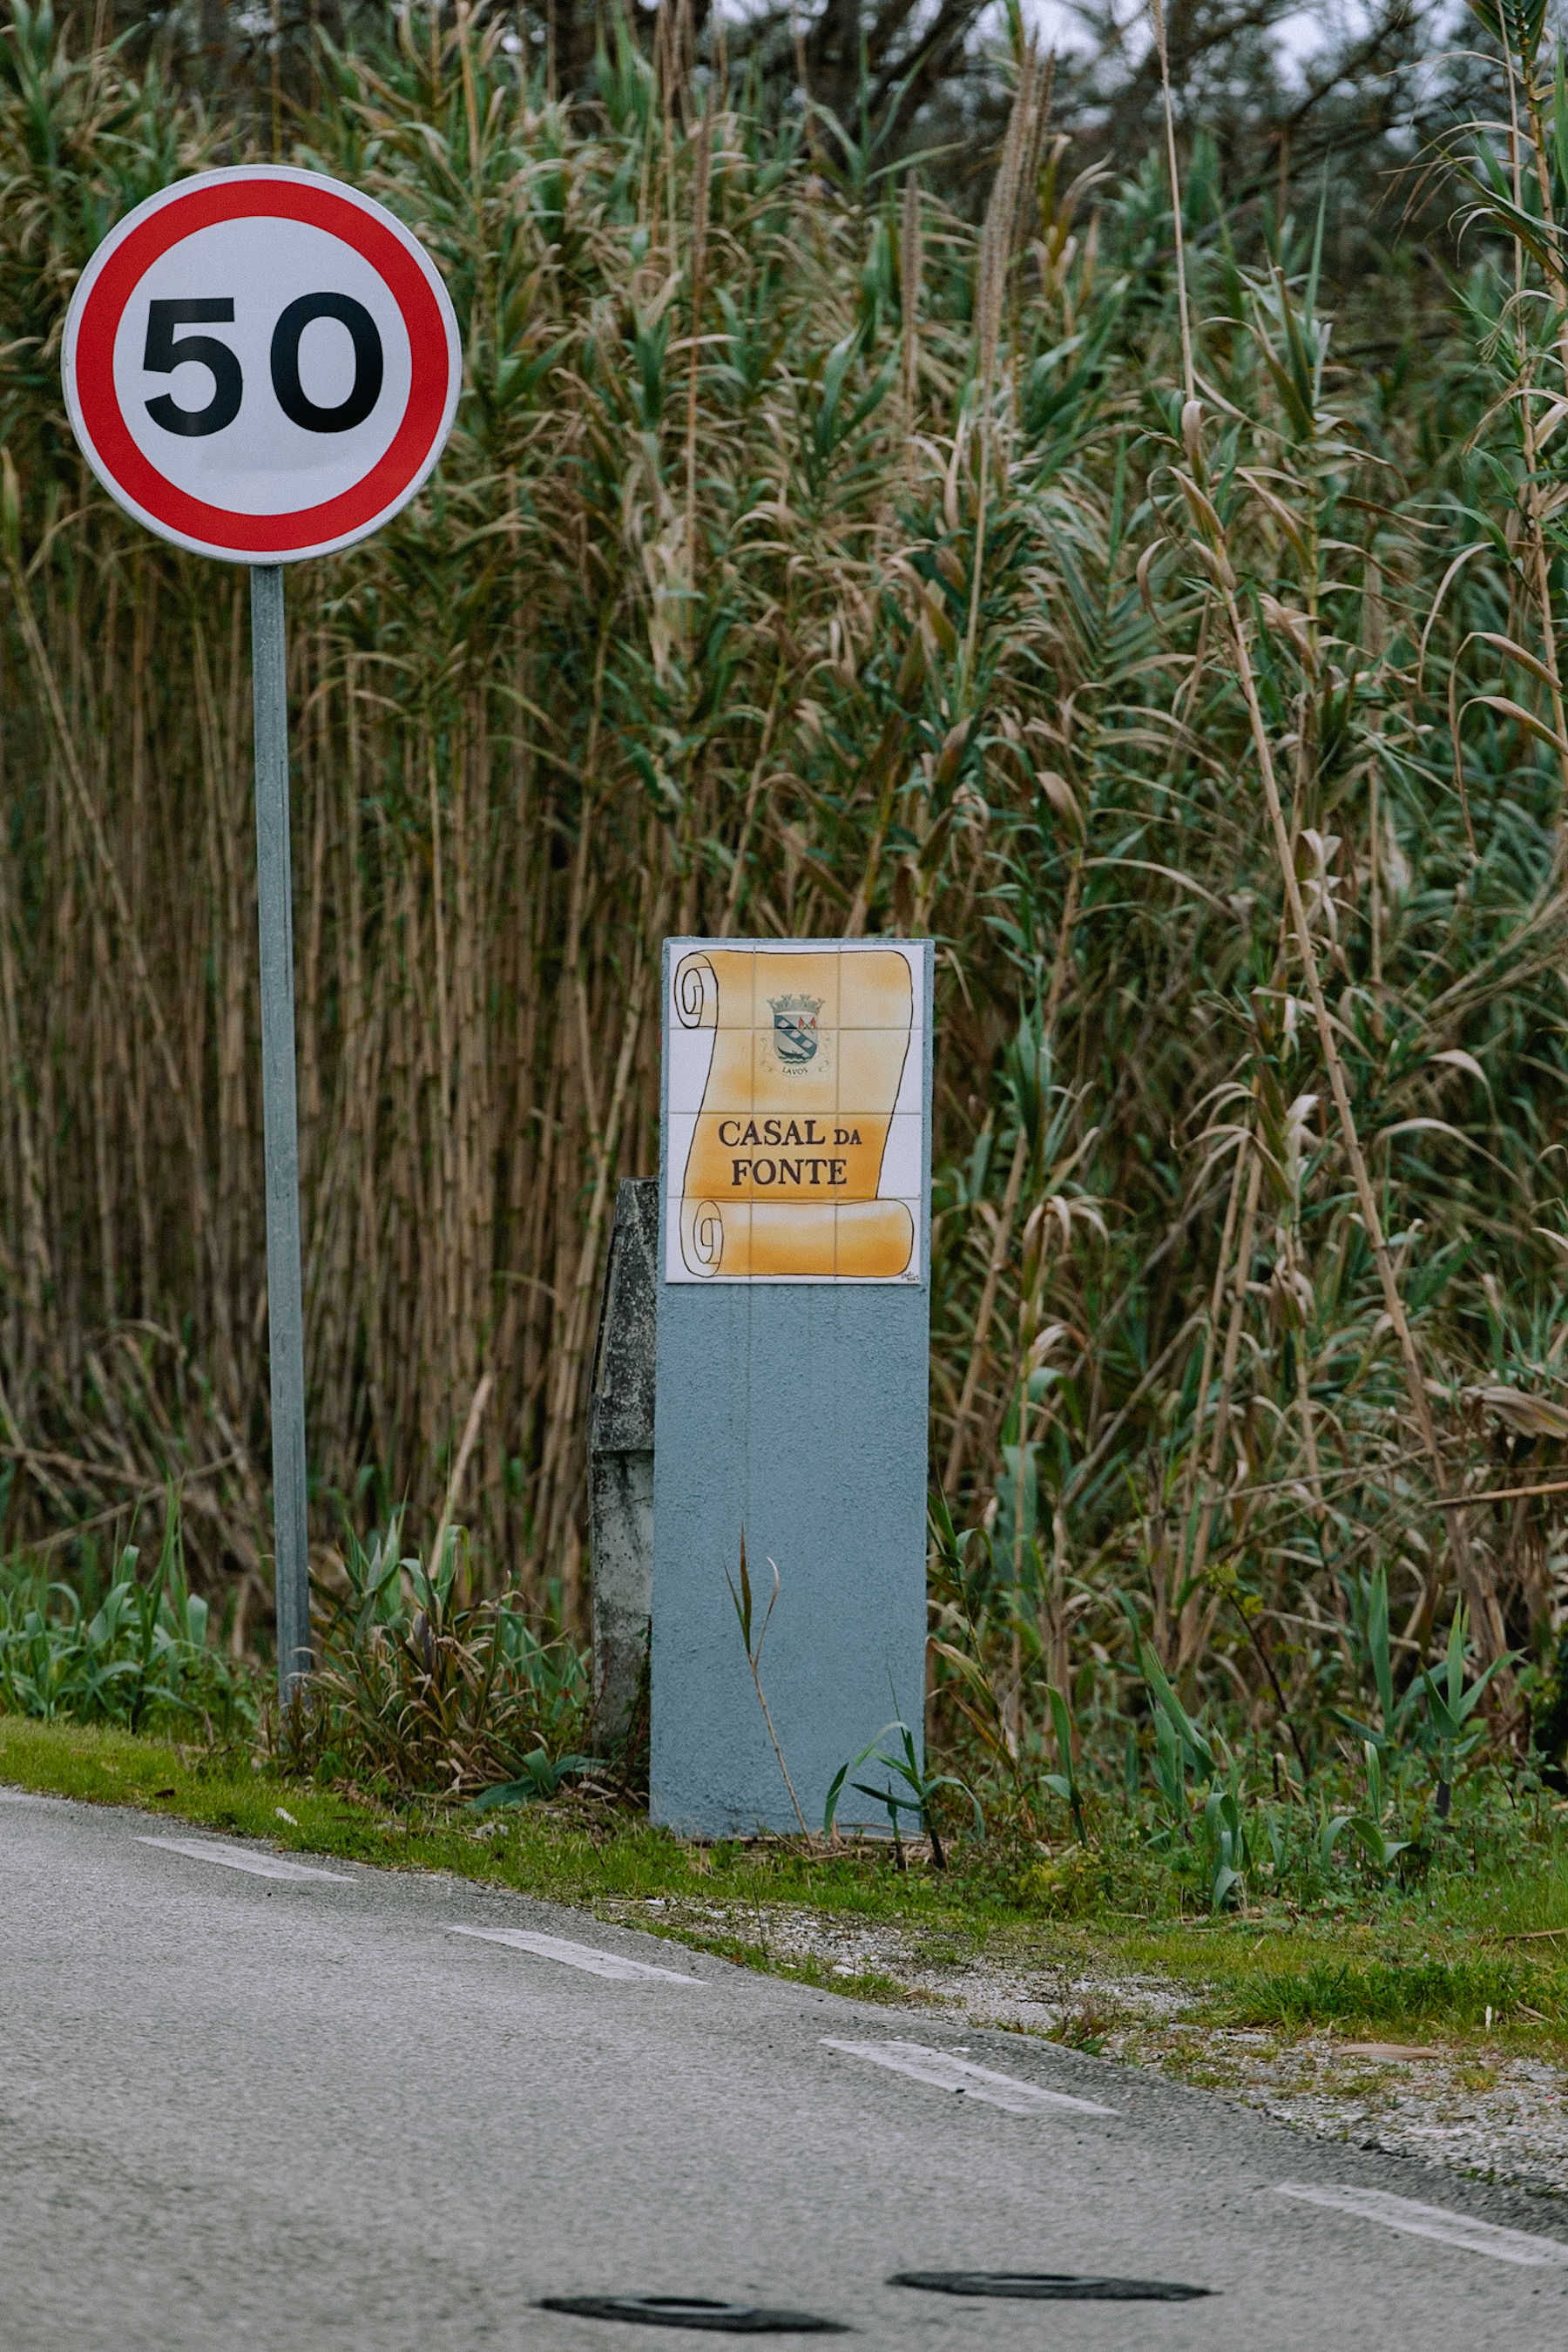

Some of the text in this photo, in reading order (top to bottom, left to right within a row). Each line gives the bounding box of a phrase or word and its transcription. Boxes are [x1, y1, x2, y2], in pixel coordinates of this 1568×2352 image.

[143, 292, 383, 437] 50
[782, 1066, 808, 1075] LAVOS
[719, 1119, 862, 1146] CASAL DA
[732, 1159, 847, 1186] FONTE
